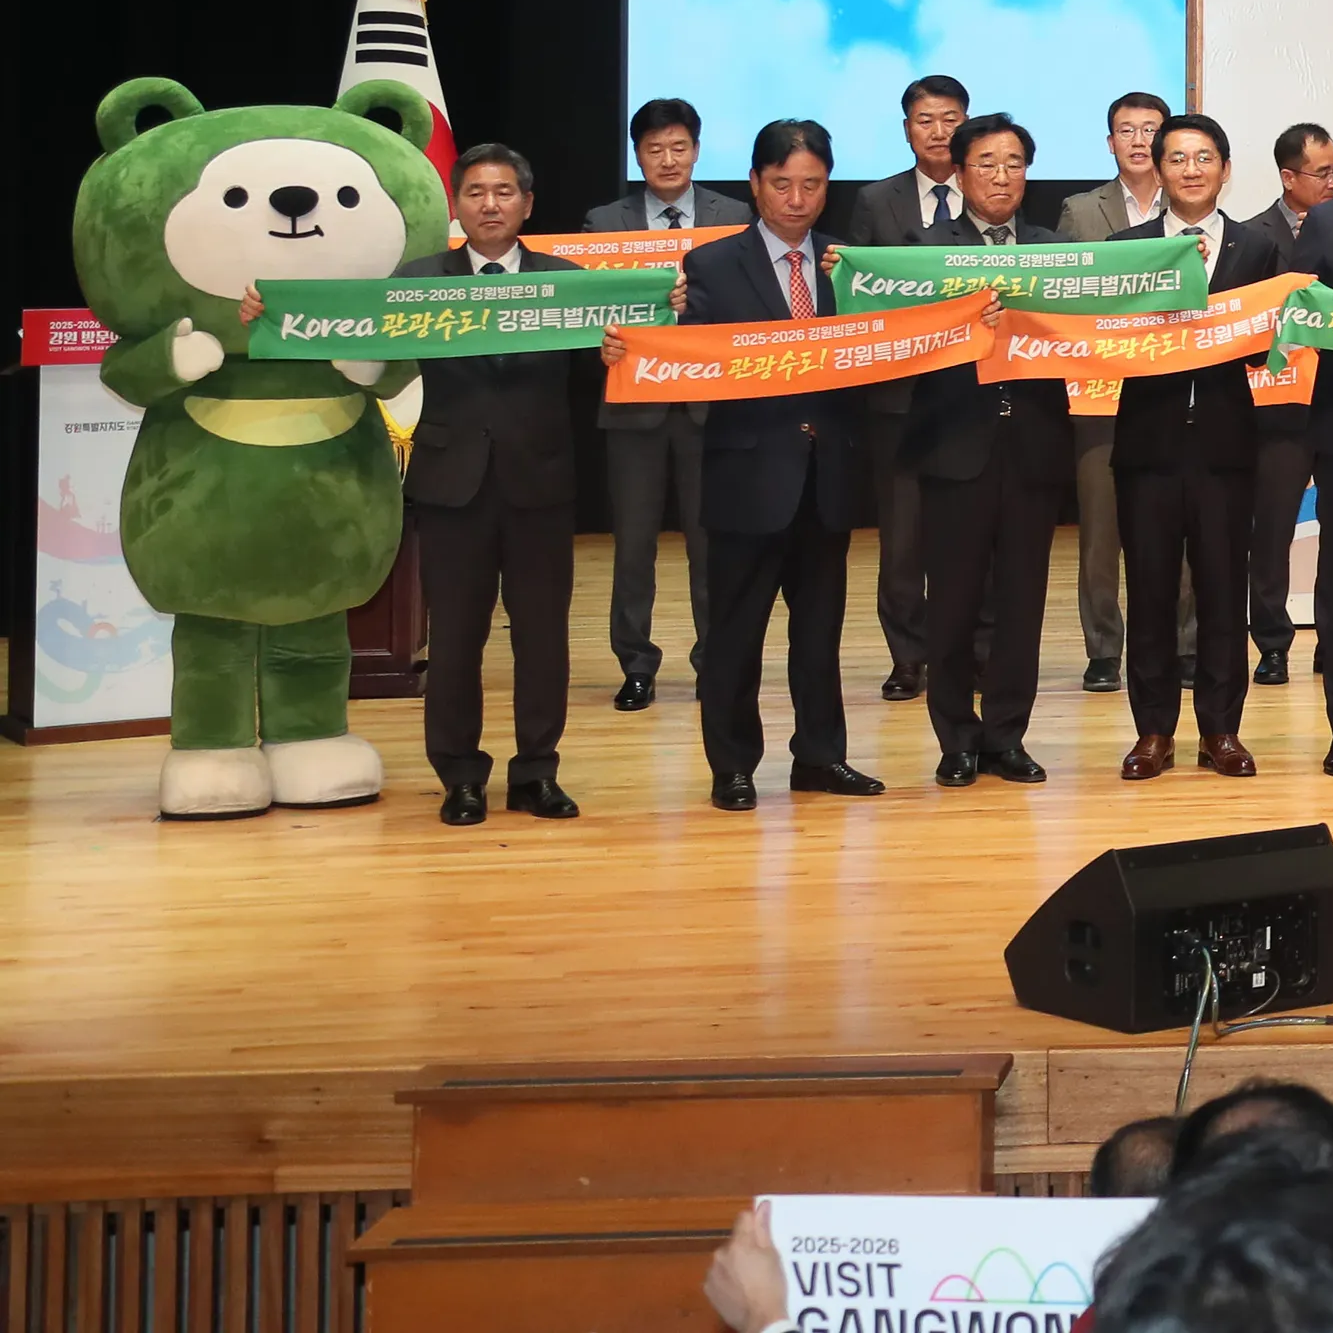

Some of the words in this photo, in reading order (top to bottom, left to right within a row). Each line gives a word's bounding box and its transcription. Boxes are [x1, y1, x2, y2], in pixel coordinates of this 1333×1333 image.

[552, 243, 619, 256] 2025-2026
[622, 239, 678, 254] 강원방문의
[944, 254, 1016, 267] 2025-2026
[1018, 252, 1079, 268] 강원방문의
[1082, 252, 1094, 266] 해
[386, 288, 466, 303] 2025-2026
[470, 284, 537, 301] 강원방문의
[541, 284, 555, 297] 해
[851, 271, 936, 297] Korea
[1043, 269, 1181, 300] 강원특별자치도!
[49, 320, 101, 330] 2025-2026
[281, 312, 378, 341] Korea
[381, 308, 491, 342] 관광수도!
[497, 303, 656, 332] 강원특별자치도!
[1095, 315, 1165, 330] 2025-2026
[1229, 298, 1242, 312] 해
[49, 331, 78, 345] 강원
[732, 329, 805, 347] 2025-2026
[807, 322, 869, 341] 강원방문의
[872, 319, 885, 333] 해
[1007, 334, 1091, 362] Korea
[1094, 329, 1188, 362] 관광수도!
[634, 356, 724, 385] Korea
[727, 348, 828, 381] 관광수도!
[834, 323, 972, 370] 강원특별자치도!
[791, 1237, 900, 1255] 2025-2026
[792, 1261, 903, 1298] VISIT
